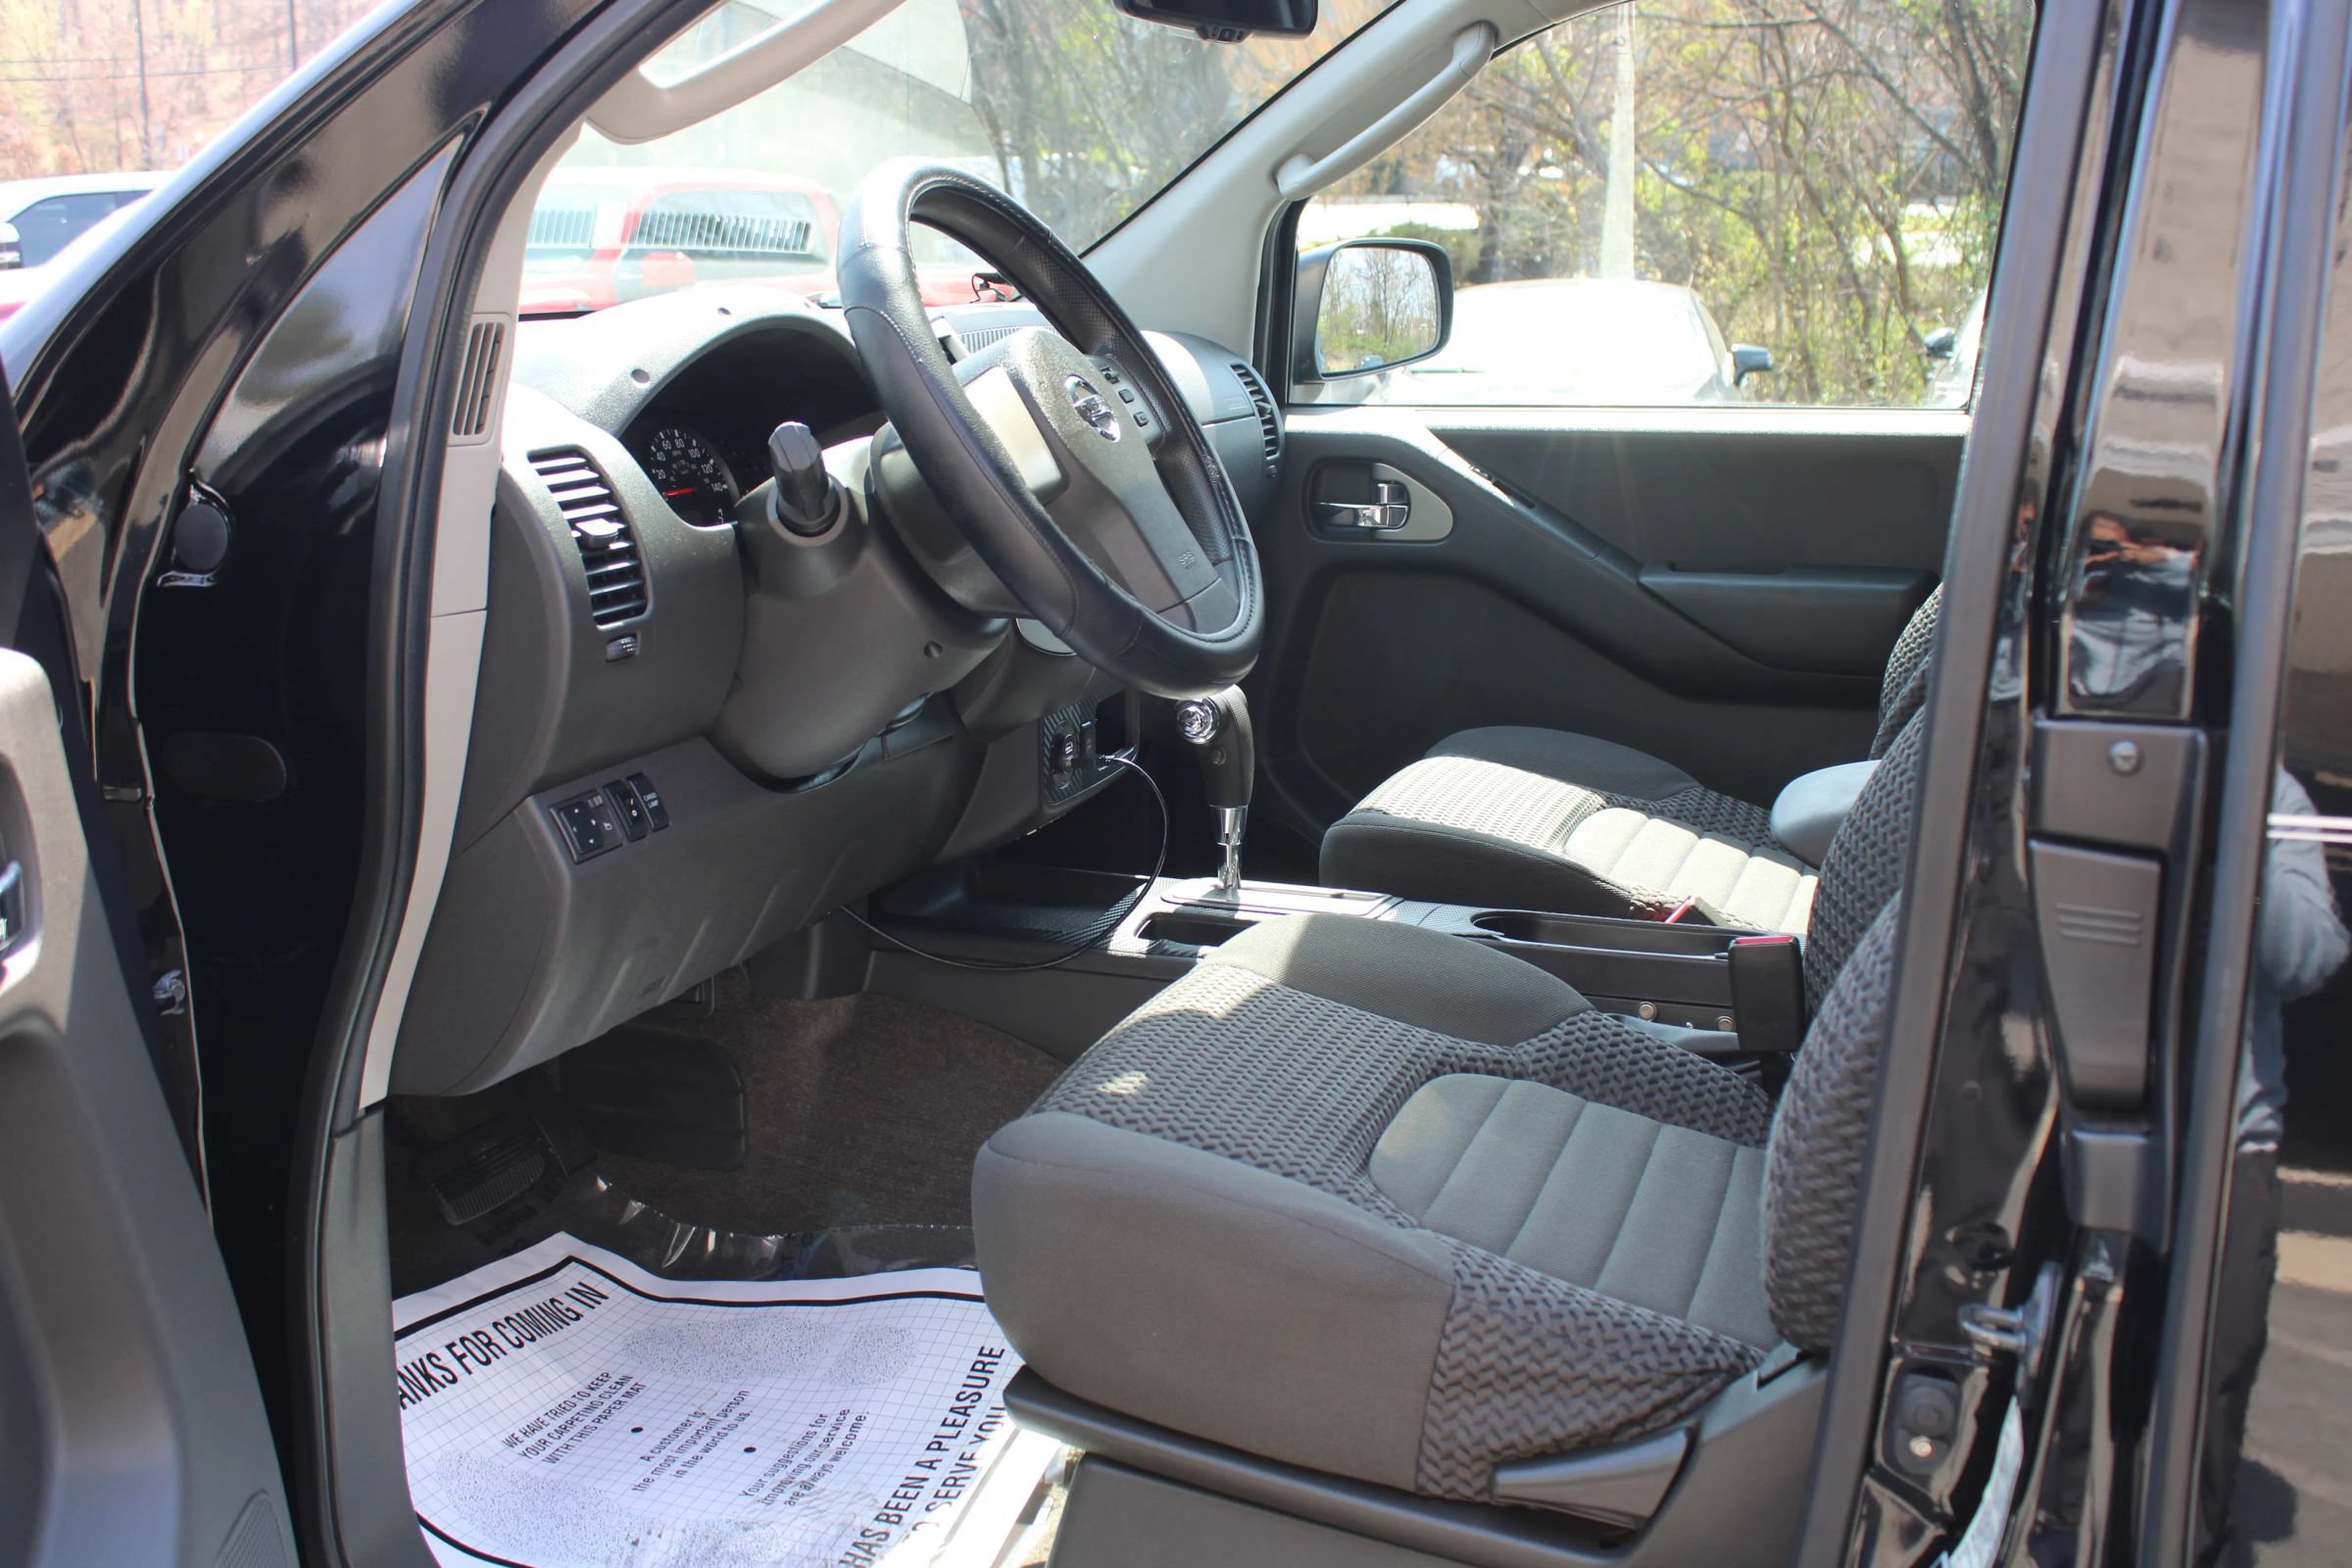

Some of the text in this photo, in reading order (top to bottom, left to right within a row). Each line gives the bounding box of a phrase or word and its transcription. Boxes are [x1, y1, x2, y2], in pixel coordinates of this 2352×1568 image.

[657, 451, 666, 462] 40
[662, 440, 672, 450] 60
[674, 438, 685, 449] 80
[688, 448, 701, 459] 100
[657, 469, 666, 479] 20
[702, 464, 713, 473] 120
[710, 482, 723, 492] 140
[445, 1330, 508, 1375] FOR
[492, 1298, 584, 1348] COMING
[564, 1282, 609, 1309] IN
[502, 1372, 612, 1448] WE HAVE TRIED TO KEEP
[518, 1375, 634, 1459] YOUR CARPETING CLEAN
[925, 1346, 1004, 1451] PLEASURE
[542, 1382, 647, 1464] WITH THIS PAPER MAT
[631, 1390, 750, 1492] the most important person
[650, 1418, 695, 1454] customer
[669, 1469, 688, 1478] in
[681, 1454, 704, 1468] the
[699, 1431, 729, 1453] world
[721, 1423, 738, 1432] to
[739, 1413, 828, 1496] Your suggestions for
[757, 1409, 850, 1505] improving our service
[914, 1458, 943, 1470] A
[784, 1491, 805, 1506] are
[800, 1463, 834, 1491] always
[873, 1476, 930, 1525] BEEN
[925, 1451, 977, 1512] SERVE
[839, 1528, 891, 1568] HAS
